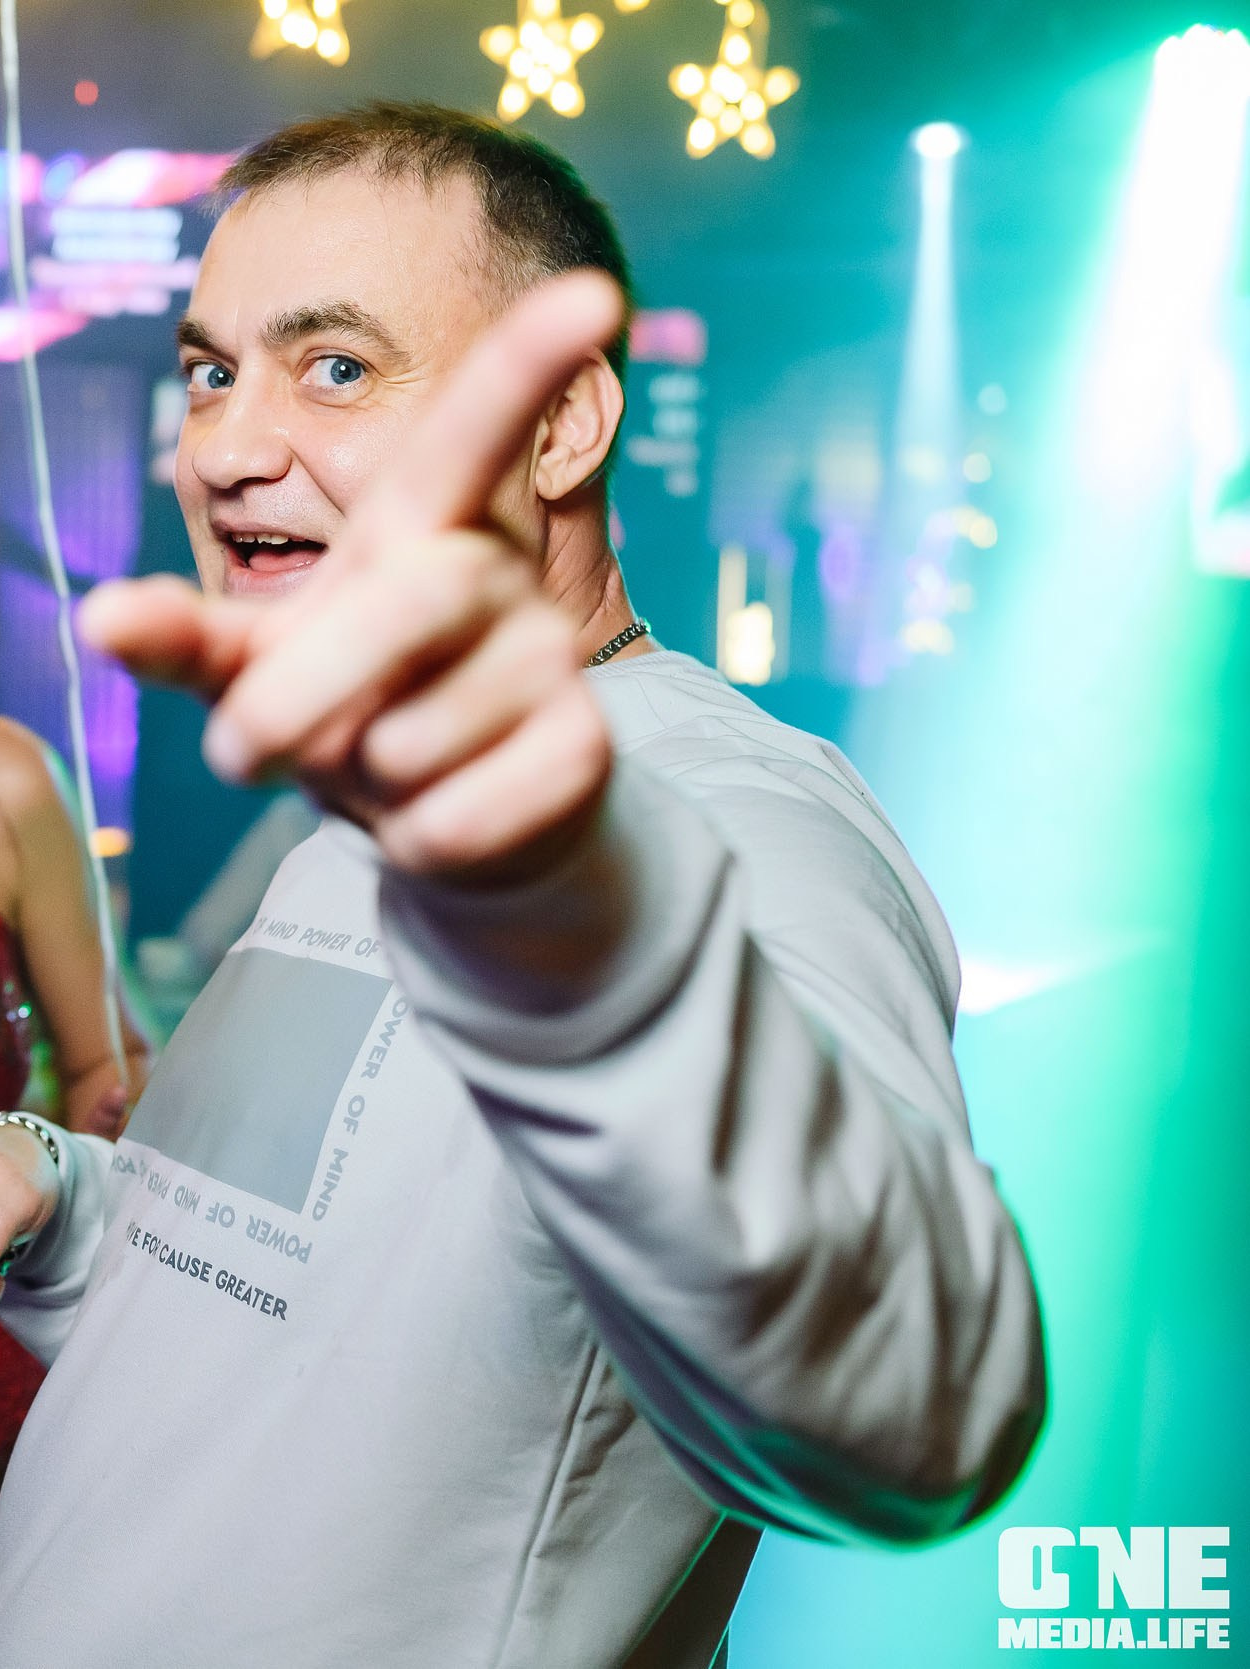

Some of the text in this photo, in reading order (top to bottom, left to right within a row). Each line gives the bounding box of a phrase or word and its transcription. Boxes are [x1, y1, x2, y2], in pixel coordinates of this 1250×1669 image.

[265, 918, 299, 940] MIND
[298, 927, 352, 952] POWER
[354, 937, 382, 958] OF
[312, 995, 410, 1222] OWER OF MIND
[205, 1202, 236, 1228] OF
[246, 1214, 313, 1264] POWER
[159, 1243, 213, 1283] CAUSE
[215, 1269, 288, 1321] GREATER
